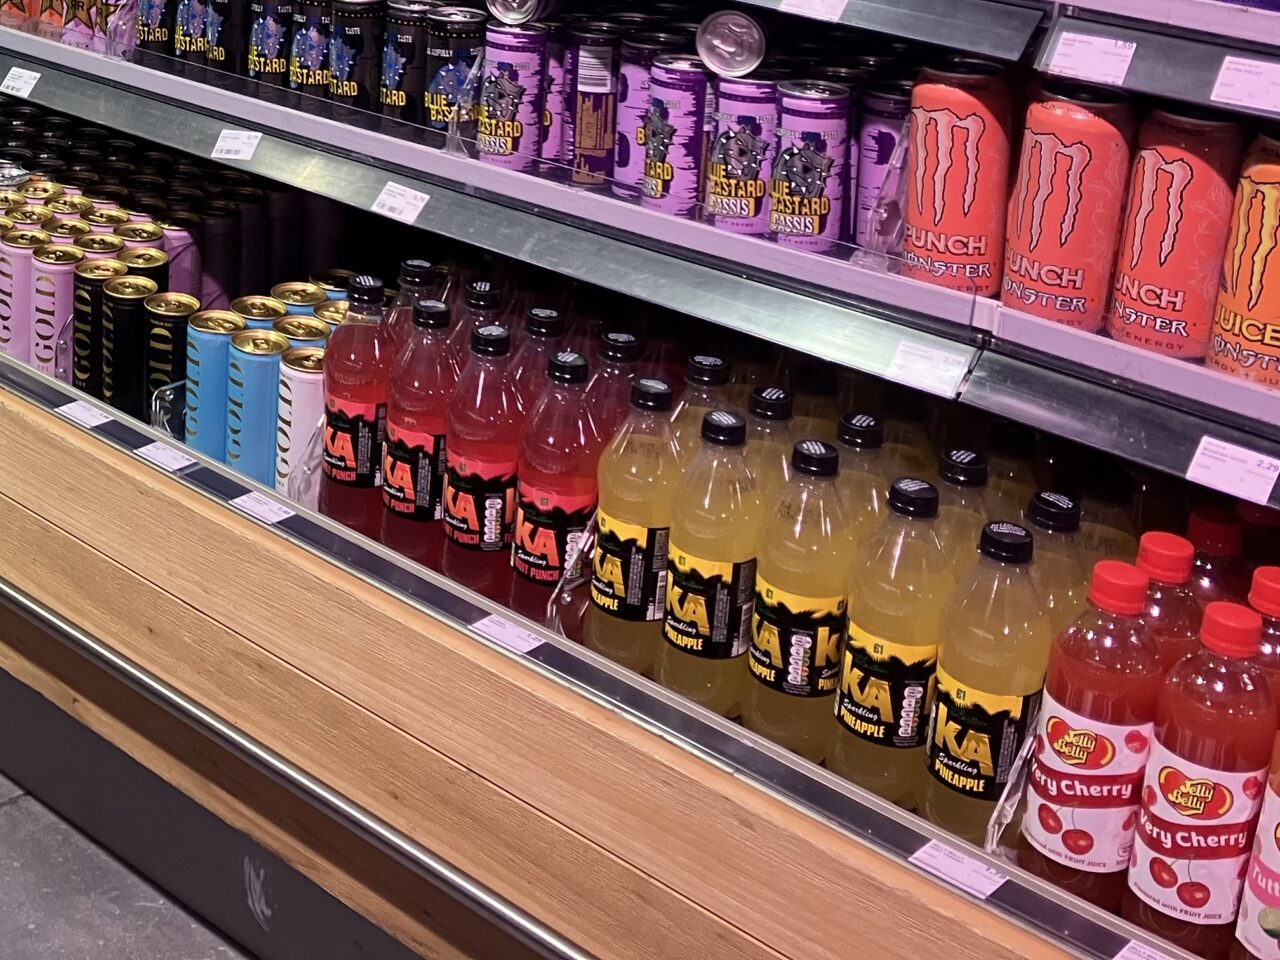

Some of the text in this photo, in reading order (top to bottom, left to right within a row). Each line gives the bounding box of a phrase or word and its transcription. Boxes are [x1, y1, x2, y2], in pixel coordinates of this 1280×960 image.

[425, 91, 448, 108] BLUE
[710, 178, 765, 198] BASTARD
[708, 196, 750, 214] CASSIS
[772, 195, 830, 216] BASTARD
[770, 213, 815, 235] CASSIS
[903, 224, 987, 257] PUNCH
[1116, 272, 1185, 313] UNCH
[34, 273, 57, 366] GOLD
[74, 287, 94, 382] GOLD
[276, 376, 294, 483] GOLD
[323, 424, 357, 468] KA
[332, 466, 356, 481] PUNCH
[384, 453, 416, 500] KA
[391, 499, 415, 513] PUNCH
[443, 483, 480, 532] KA
[453, 529, 480, 545] PUNCH
[516, 507, 561, 567] KA
[530, 565, 559, 582] PUNCH
[665, 580, 711, 637] KA
[665, 614, 697, 635] Sparkling
[841, 650, 894, 724] KA
[842, 698, 879, 722] Sparkling
[840, 710, 886, 739] PINEAPPLE
[935, 704, 995, 777] KA
[1054, 737, 1089, 761] Belly
[1064, 729, 1096, 752] Jelly
[934, 758, 986, 793] PINEAPPLE
[937, 751, 979, 777] Sparkling
[1061, 776, 1132, 799] Cherry
[1168, 787, 1206, 814] Belly
[1179, 777, 1214, 800] Jelly
[1141, 811, 1247, 851] Very Cherry
[1251, 867, 1280, 898] Tutt
[1179, 907, 1200, 918] FRUIT
[1201, 912, 1223, 921] JUICE
